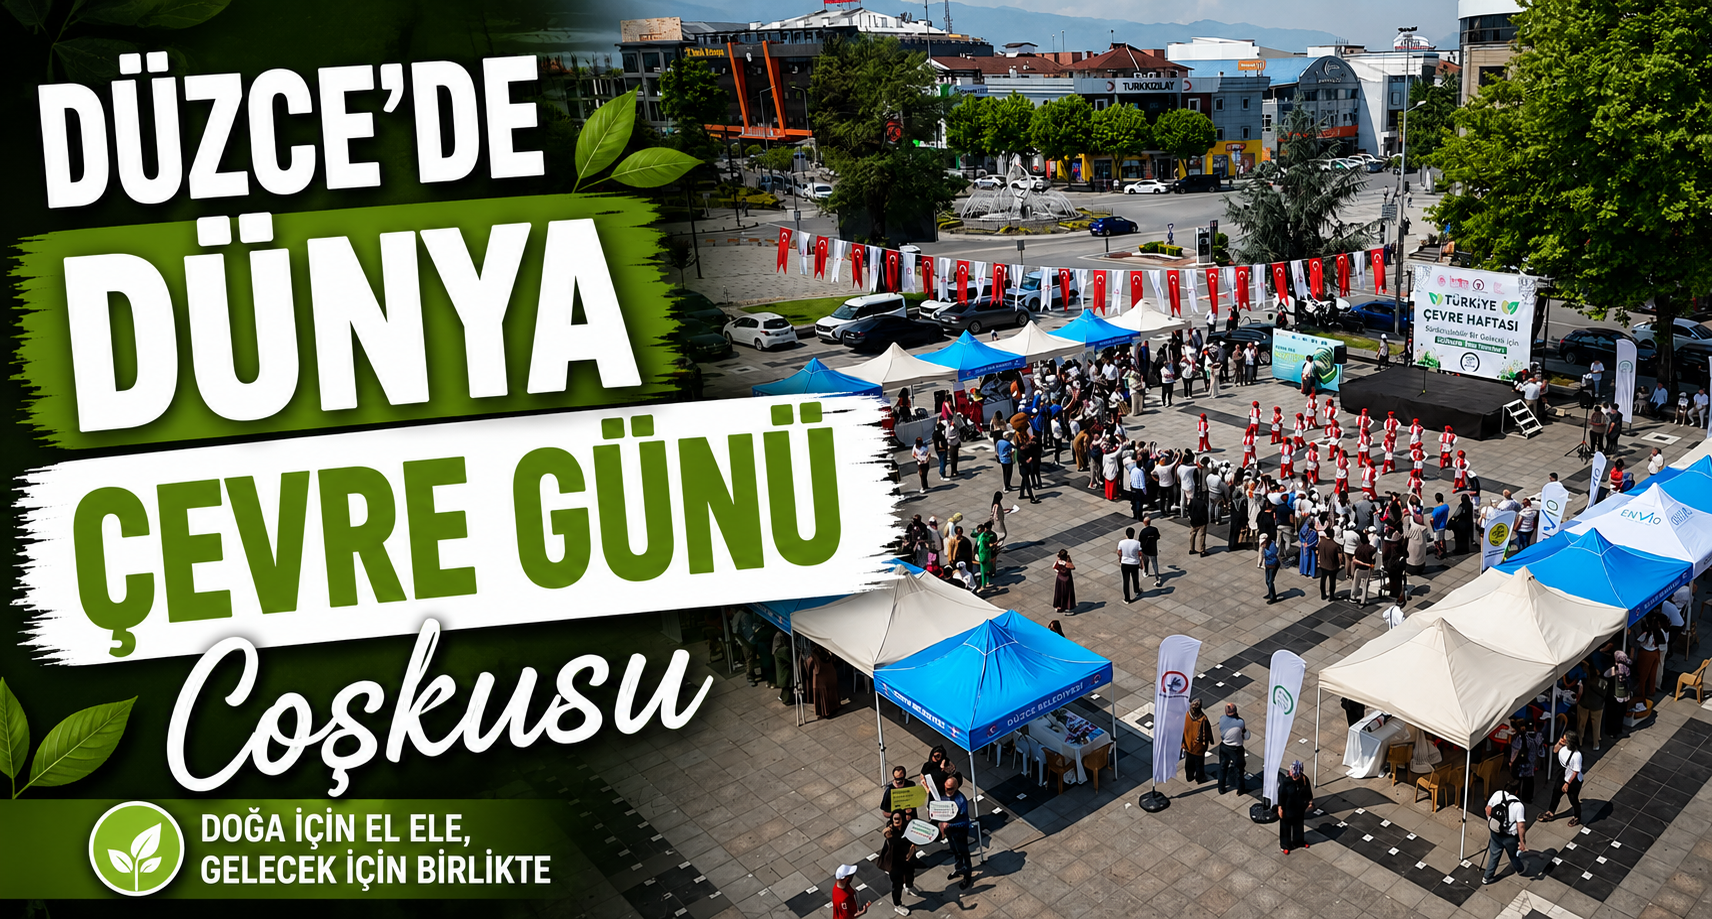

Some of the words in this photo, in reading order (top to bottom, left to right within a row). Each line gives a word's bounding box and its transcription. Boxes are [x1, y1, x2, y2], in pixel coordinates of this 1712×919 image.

[1444, 293, 1497, 312] TÜRKİYE
[1423, 308, 1464, 324] ÇEVRE
[1466, 314, 1519, 332] HAFTASI
